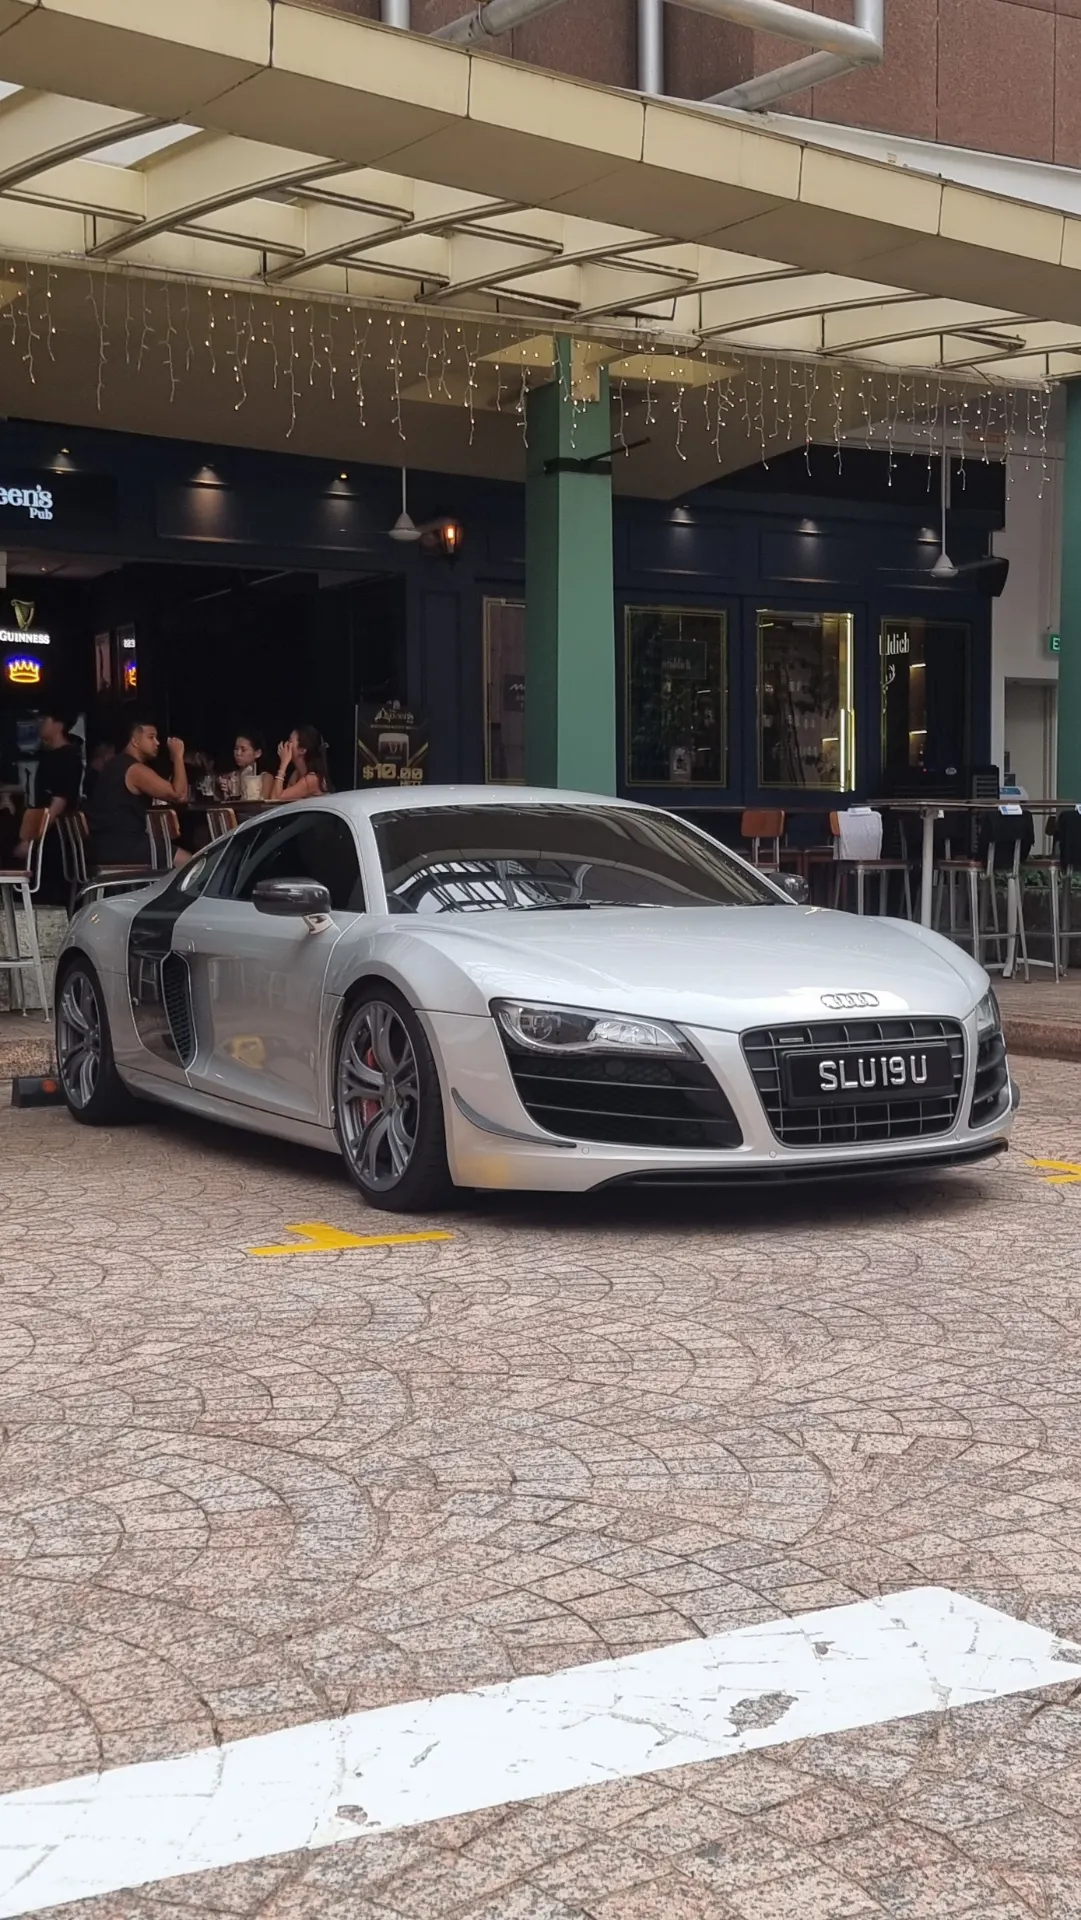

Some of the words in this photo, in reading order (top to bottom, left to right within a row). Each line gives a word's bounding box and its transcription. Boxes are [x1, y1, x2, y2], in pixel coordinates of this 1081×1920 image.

[29, 506, 53, 520] Pub
[0, 630, 50, 645] GUINNESS
[1053, 637, 1061, 651] E
[363, 763, 423, 780] $10.00
[819, 1055, 927, 1091] SLU19U
